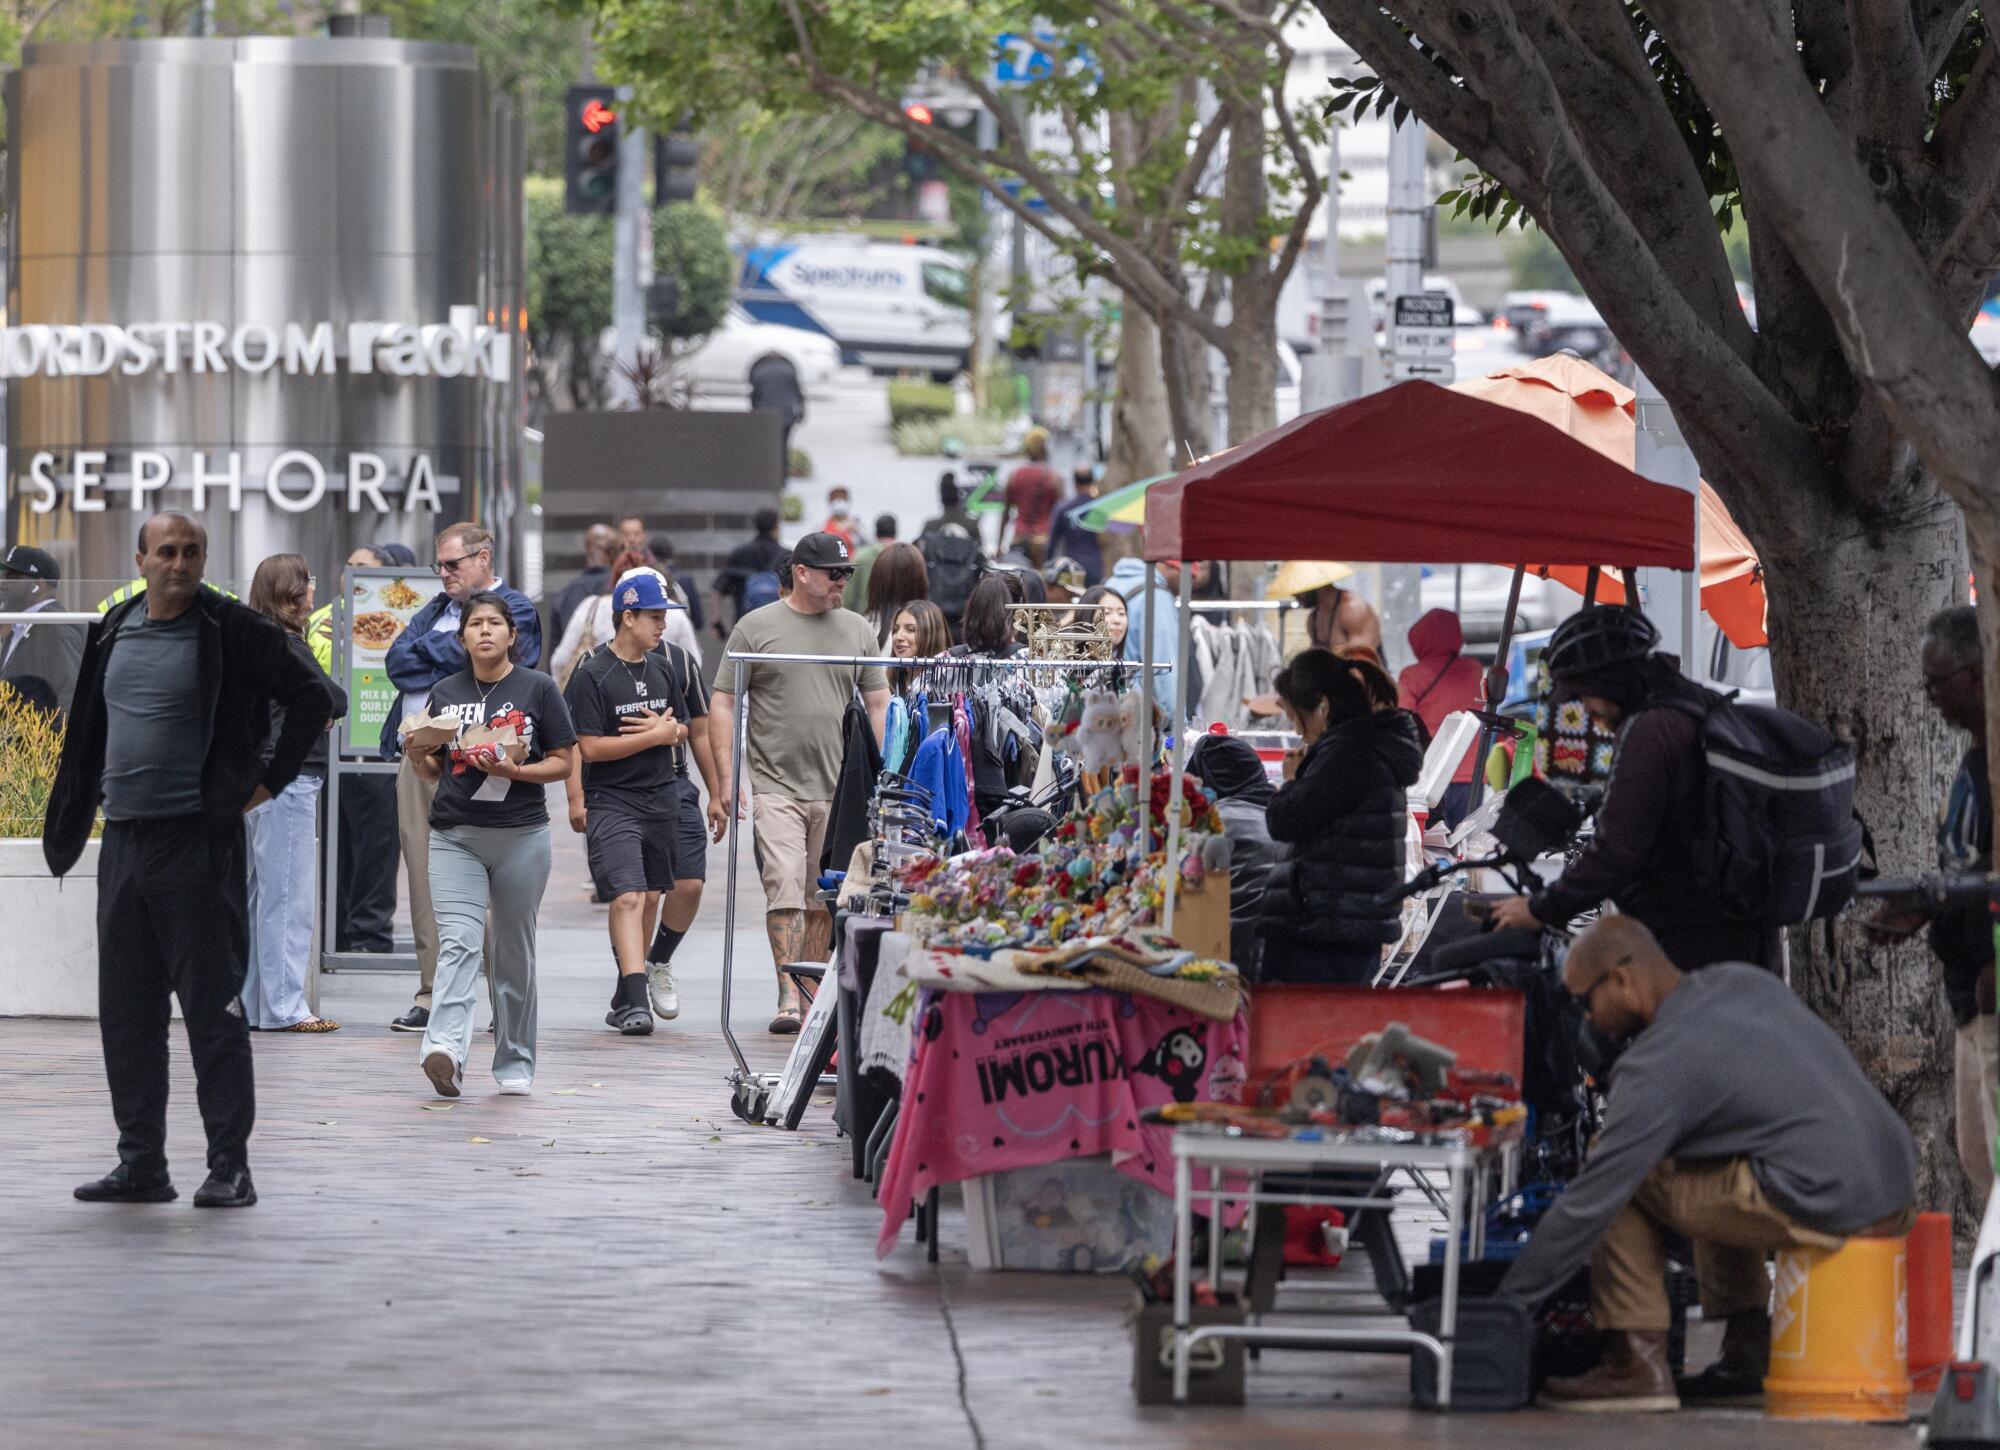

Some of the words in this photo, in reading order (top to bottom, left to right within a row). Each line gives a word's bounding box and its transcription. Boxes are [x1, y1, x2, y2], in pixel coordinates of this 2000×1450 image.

[348, 304, 512, 383] rack
[30, 450, 442, 513] SEPHORA
[360, 690, 379, 700] MIX
[380, 690, 389, 700] &
[360, 702, 382, 712] OUR
[615, 701, 649, 715] PERFECT
[995, 1026, 1083, 1050] ANNIVERSARY
[976, 1038, 1129, 1105] KUROMI
